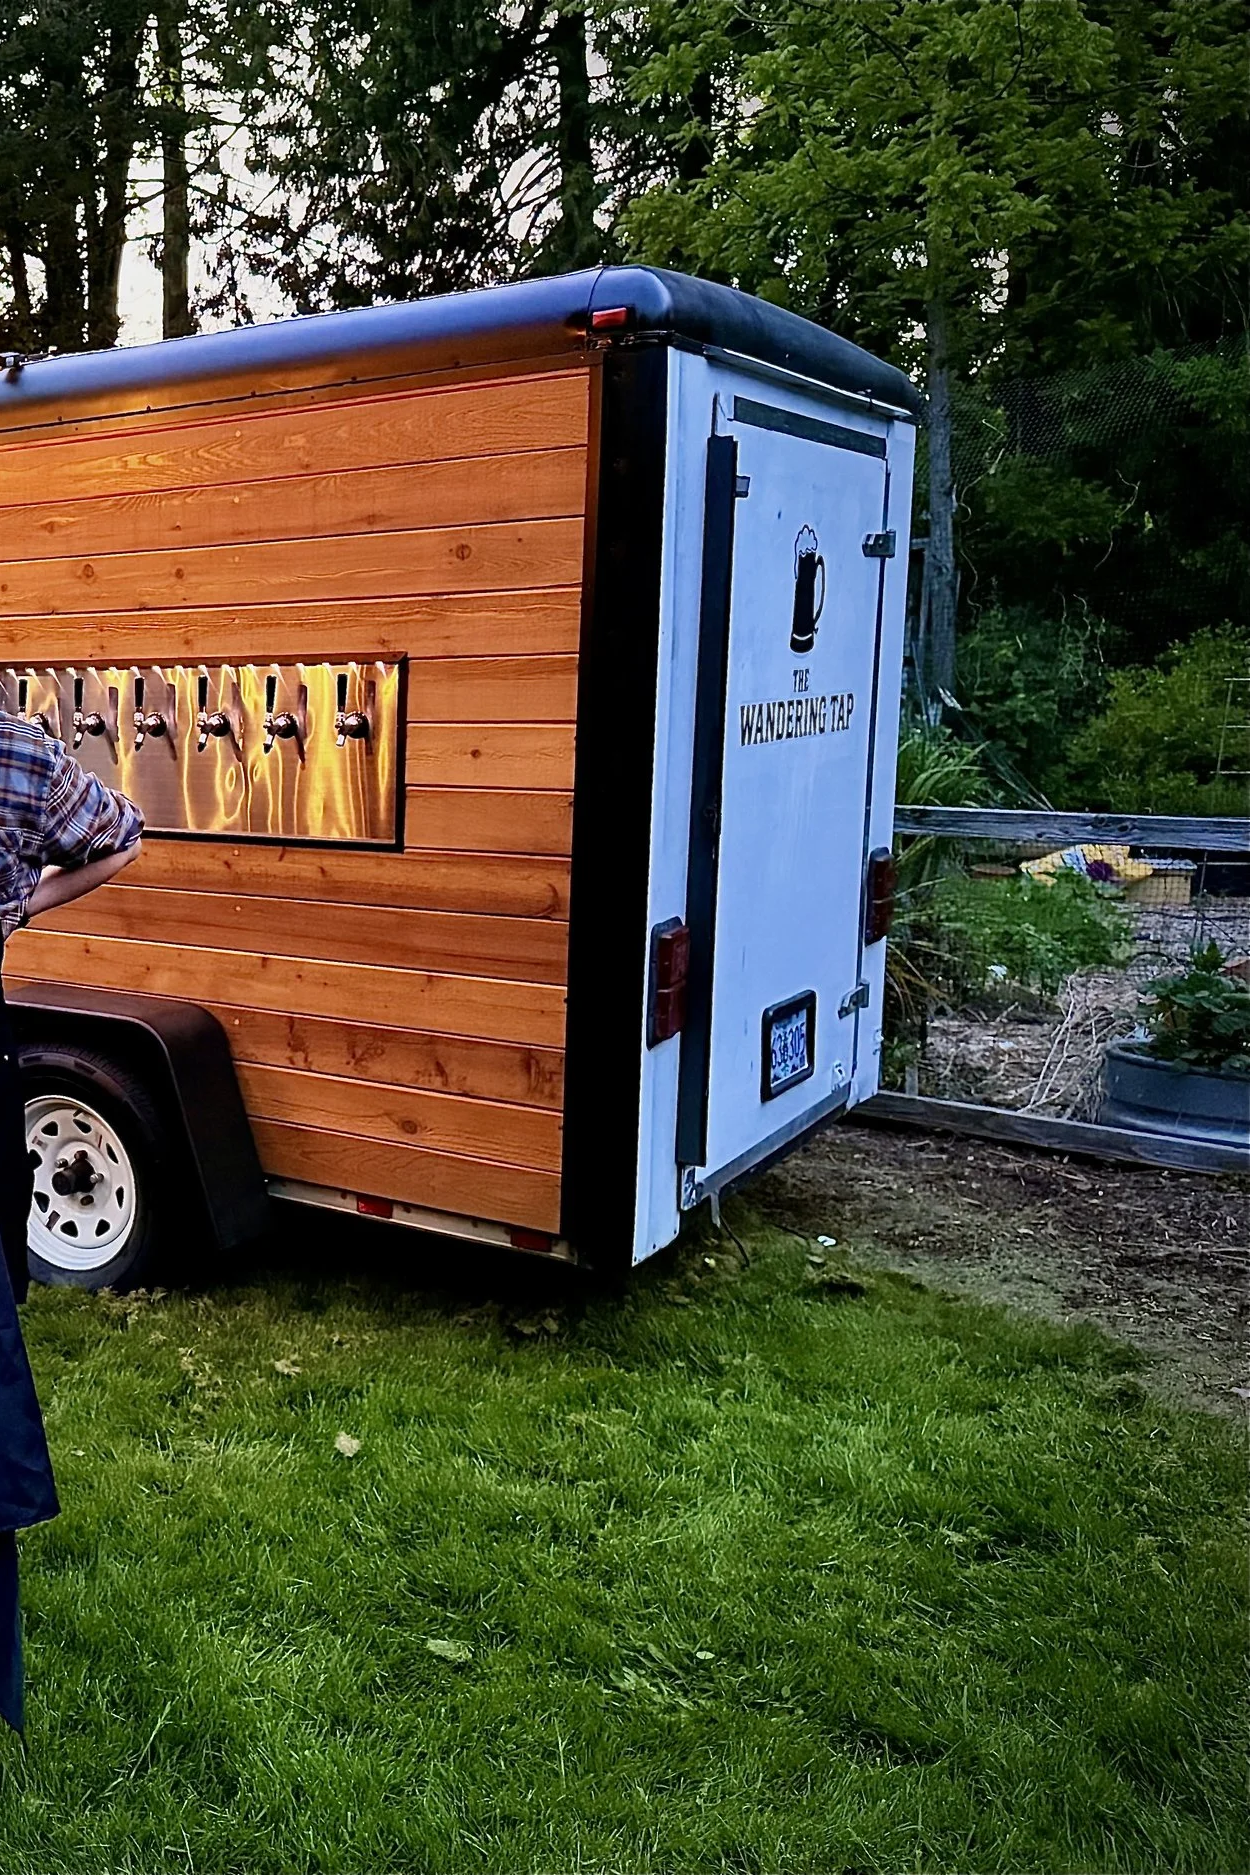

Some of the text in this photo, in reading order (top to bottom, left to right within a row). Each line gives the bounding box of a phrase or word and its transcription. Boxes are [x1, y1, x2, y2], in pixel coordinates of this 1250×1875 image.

[793, 669, 810, 692] THE
[740, 693, 854, 746] WANDERING TAP
